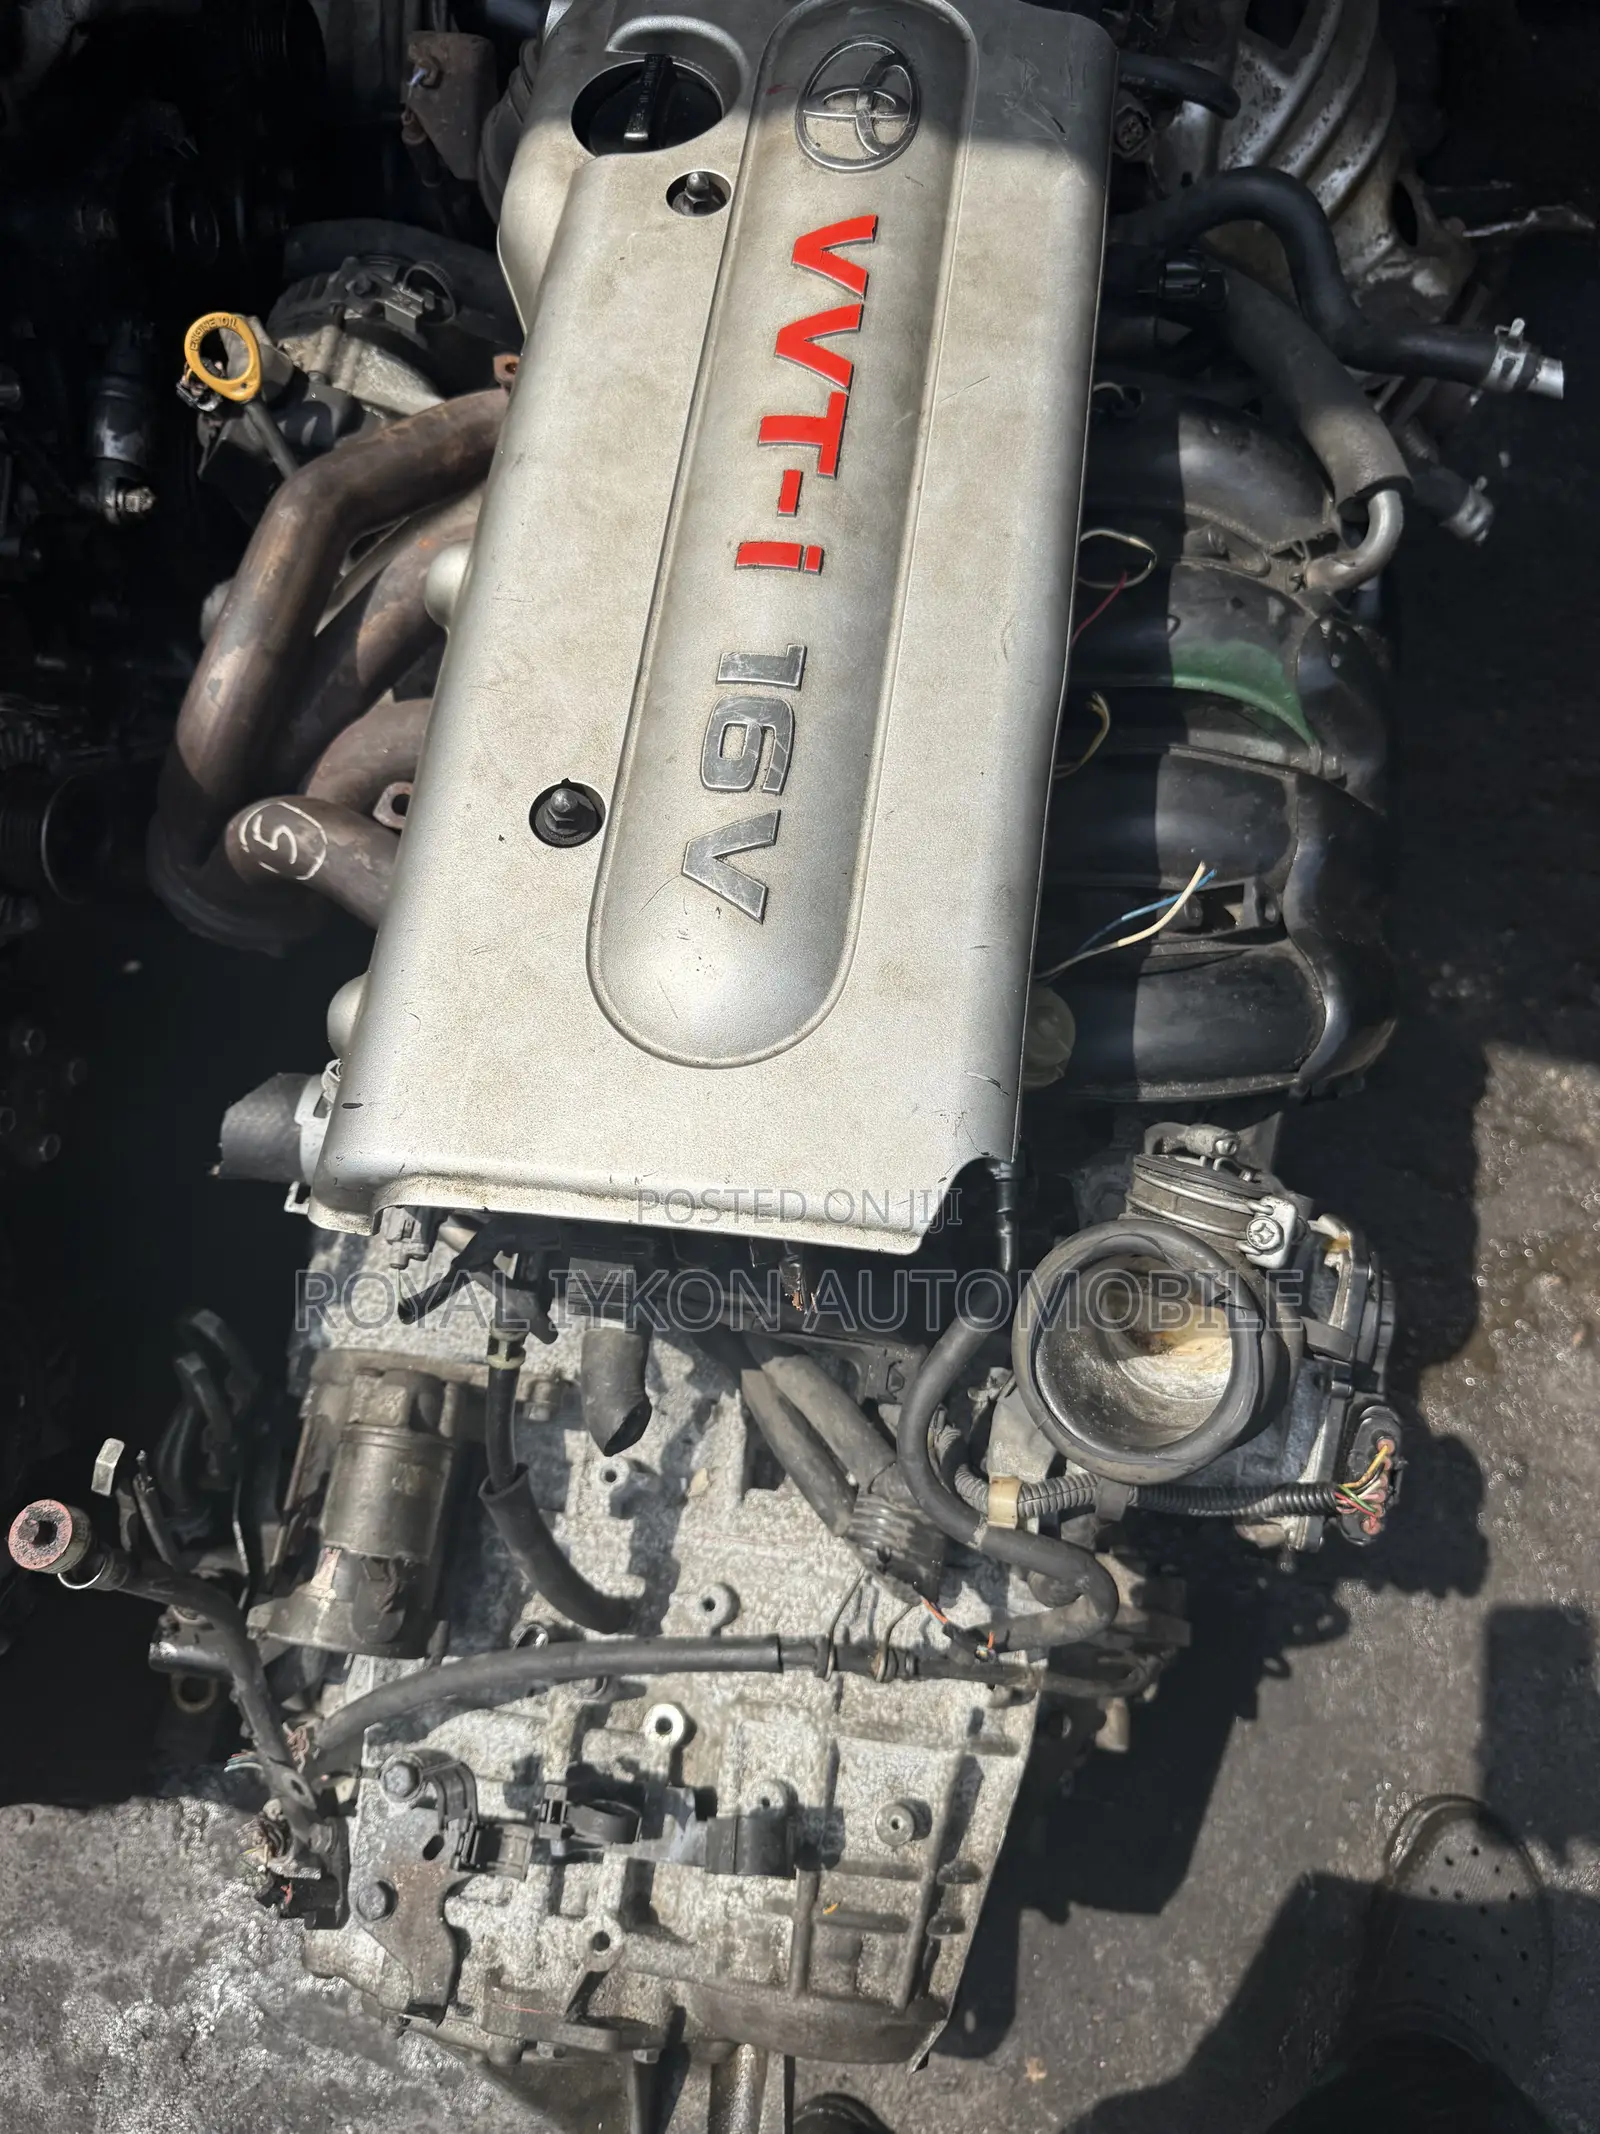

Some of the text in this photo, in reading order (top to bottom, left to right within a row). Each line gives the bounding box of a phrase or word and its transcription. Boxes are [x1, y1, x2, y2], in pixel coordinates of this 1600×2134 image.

[190, 316, 237, 351] ENGINE OIL
[681, 643, 808, 925] 16V
